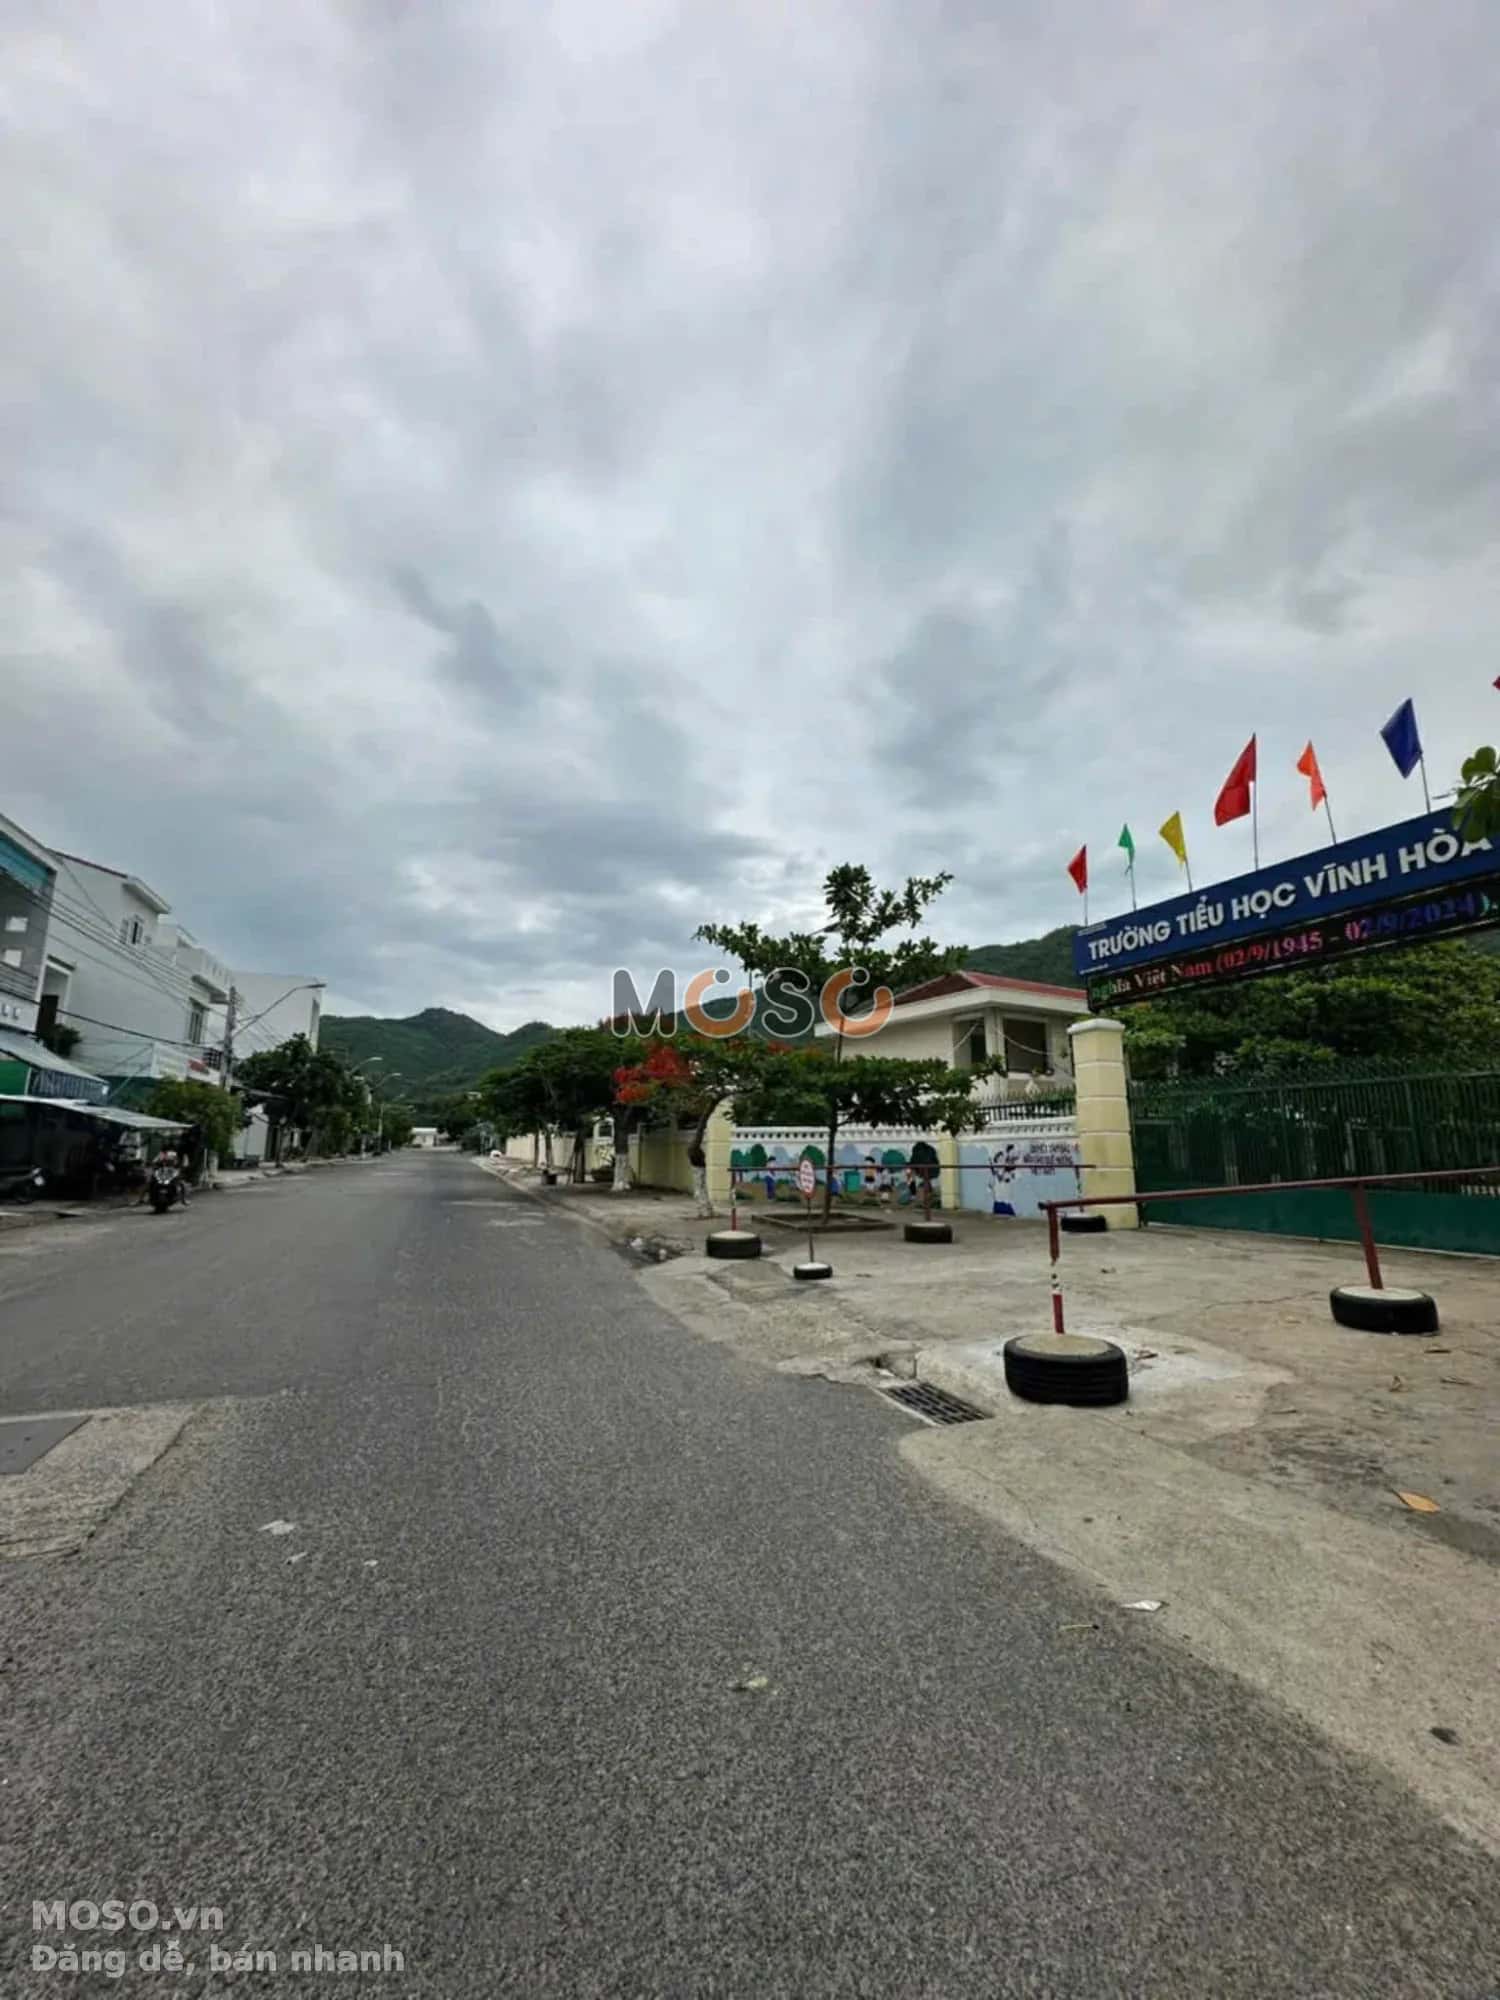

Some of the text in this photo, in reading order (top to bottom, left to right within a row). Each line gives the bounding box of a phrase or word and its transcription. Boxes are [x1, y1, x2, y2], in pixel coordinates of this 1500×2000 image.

[1088, 920, 1171, 960] TRƯỜNG
[1176, 895, 1224, 936] TIỂU
[1231, 882, 1296, 919] HỌC
[1304, 853, 1388, 898] VĨNH
[1170, 960, 1213, 978] Nam
